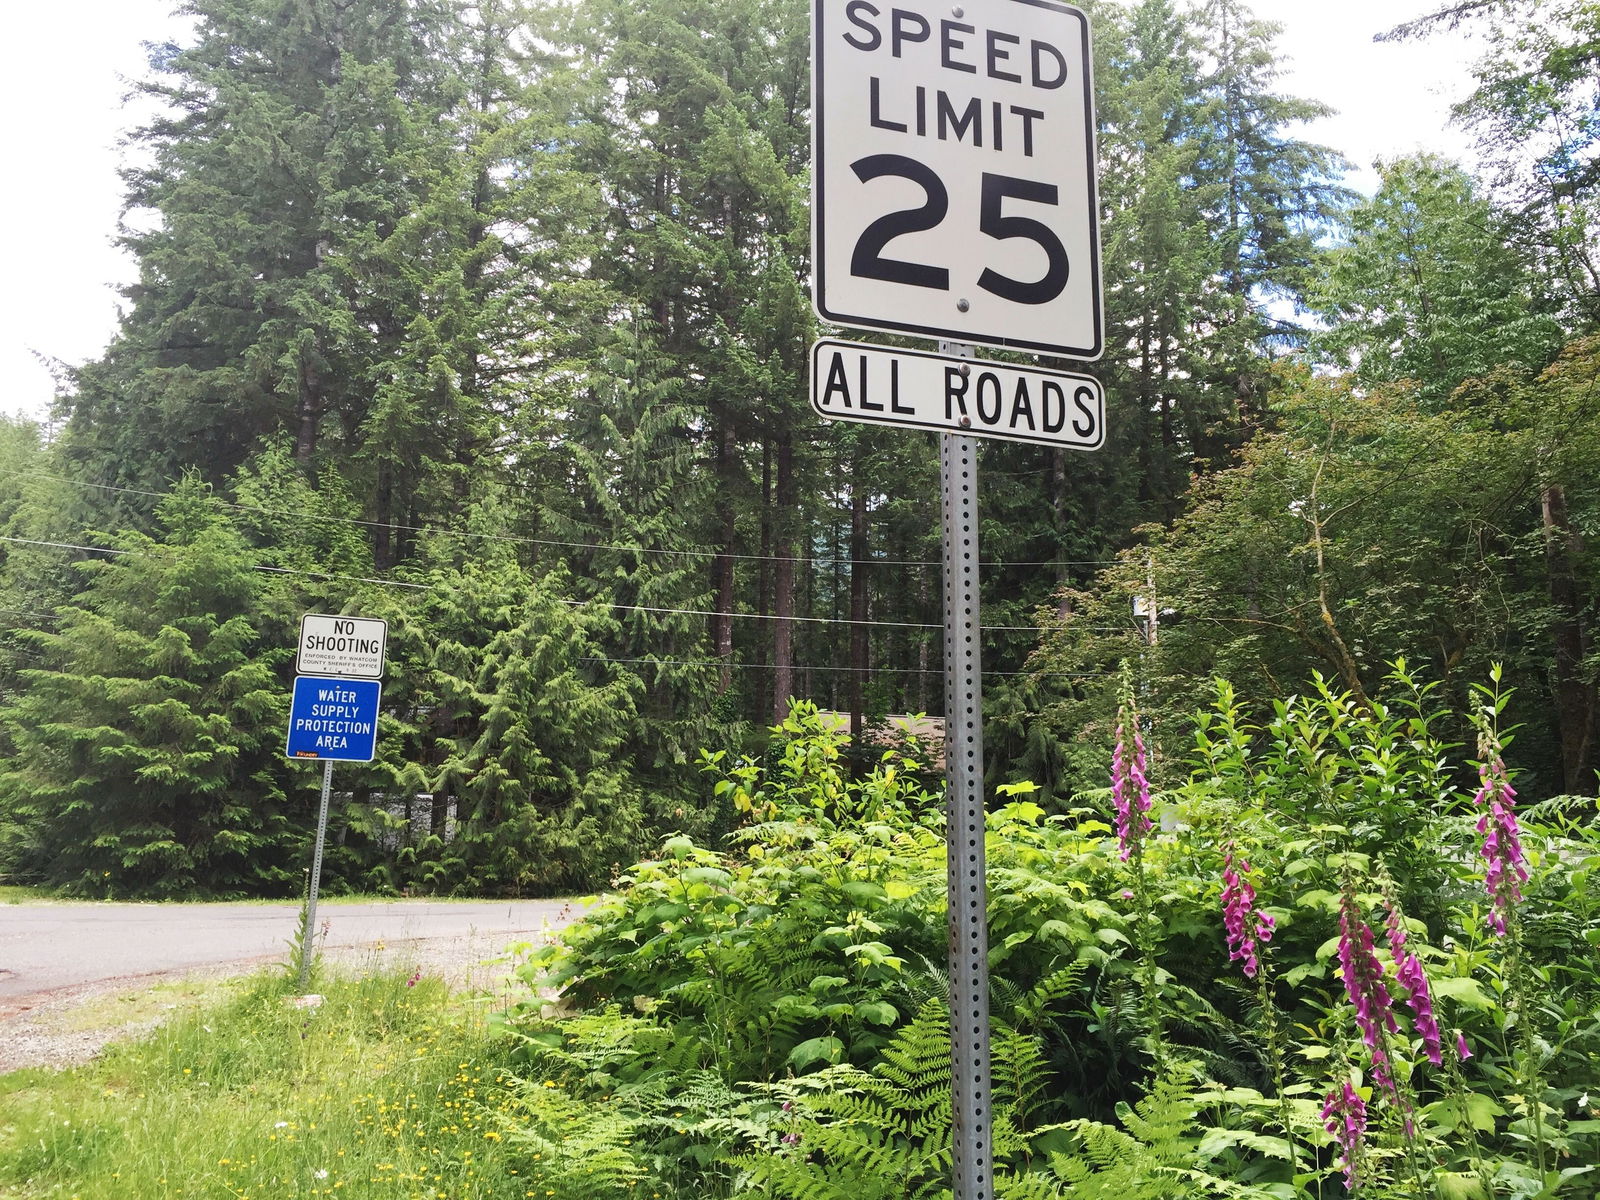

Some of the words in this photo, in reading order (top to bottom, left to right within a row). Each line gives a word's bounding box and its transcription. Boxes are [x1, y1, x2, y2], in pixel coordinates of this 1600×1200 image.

[842, 0, 1068, 90] SPEED
[870, 76, 1044, 158] LIMIT
[850, 154, 1069, 305] 25
[822, 352, 915, 415] ALL
[945, 366, 1096, 438] ROADS
[334, 620, 355, 635] NO
[306, 635, 379, 654] SHOOTING
[318, 689, 357, 703] WATER
[311, 704, 359, 718] SUPPLY
[296, 719, 371, 735] PROTECTION
[316, 735, 348, 748] AREA
